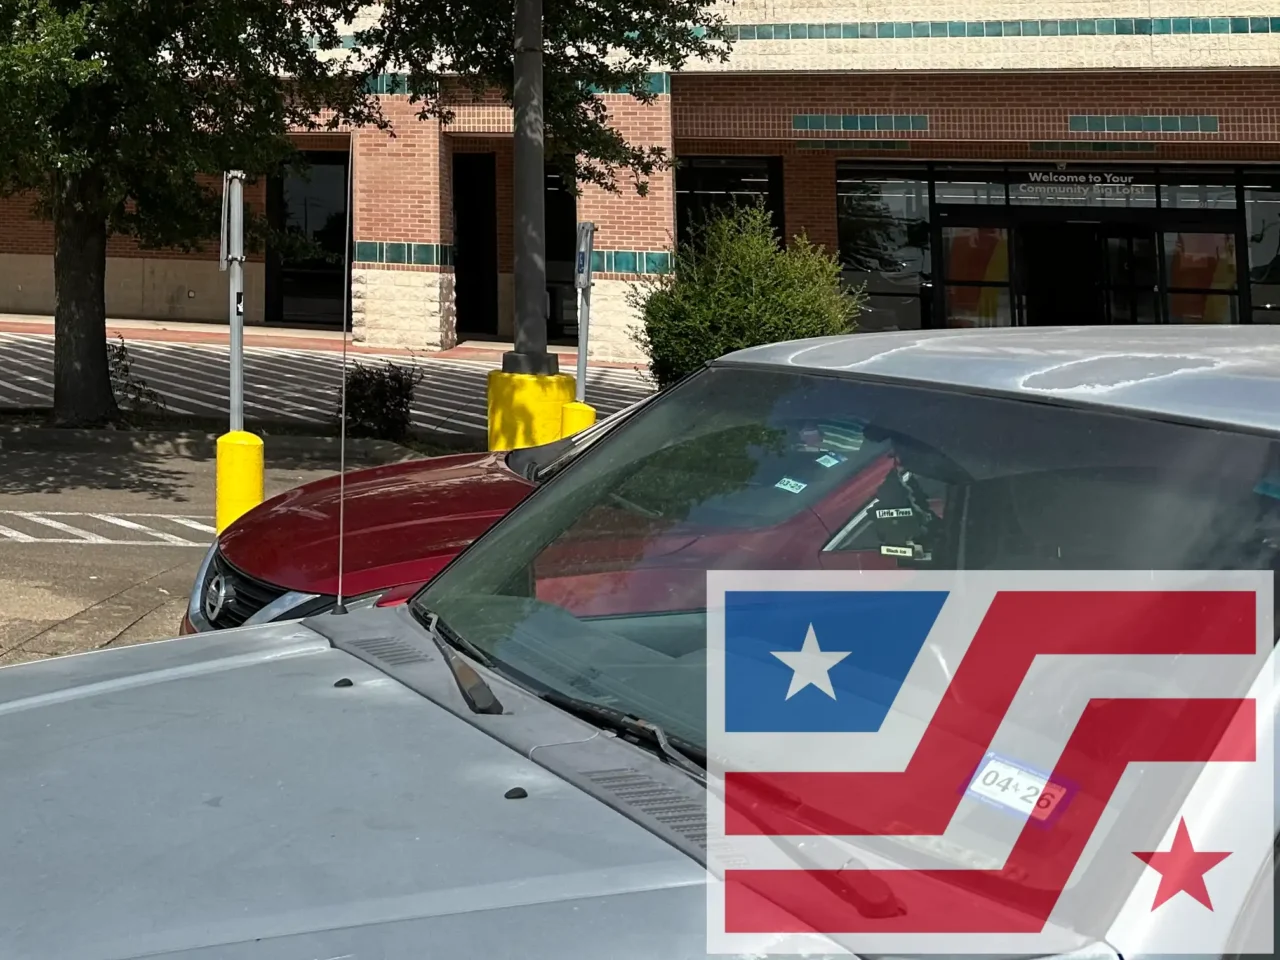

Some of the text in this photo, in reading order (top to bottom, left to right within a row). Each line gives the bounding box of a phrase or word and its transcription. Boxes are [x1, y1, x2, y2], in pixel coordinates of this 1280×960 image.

[1028, 172, 1134, 184] Welcome to Your
[1019, 184, 1145, 196] Community Big Lots!
[895, 509, 911, 517] Trees
